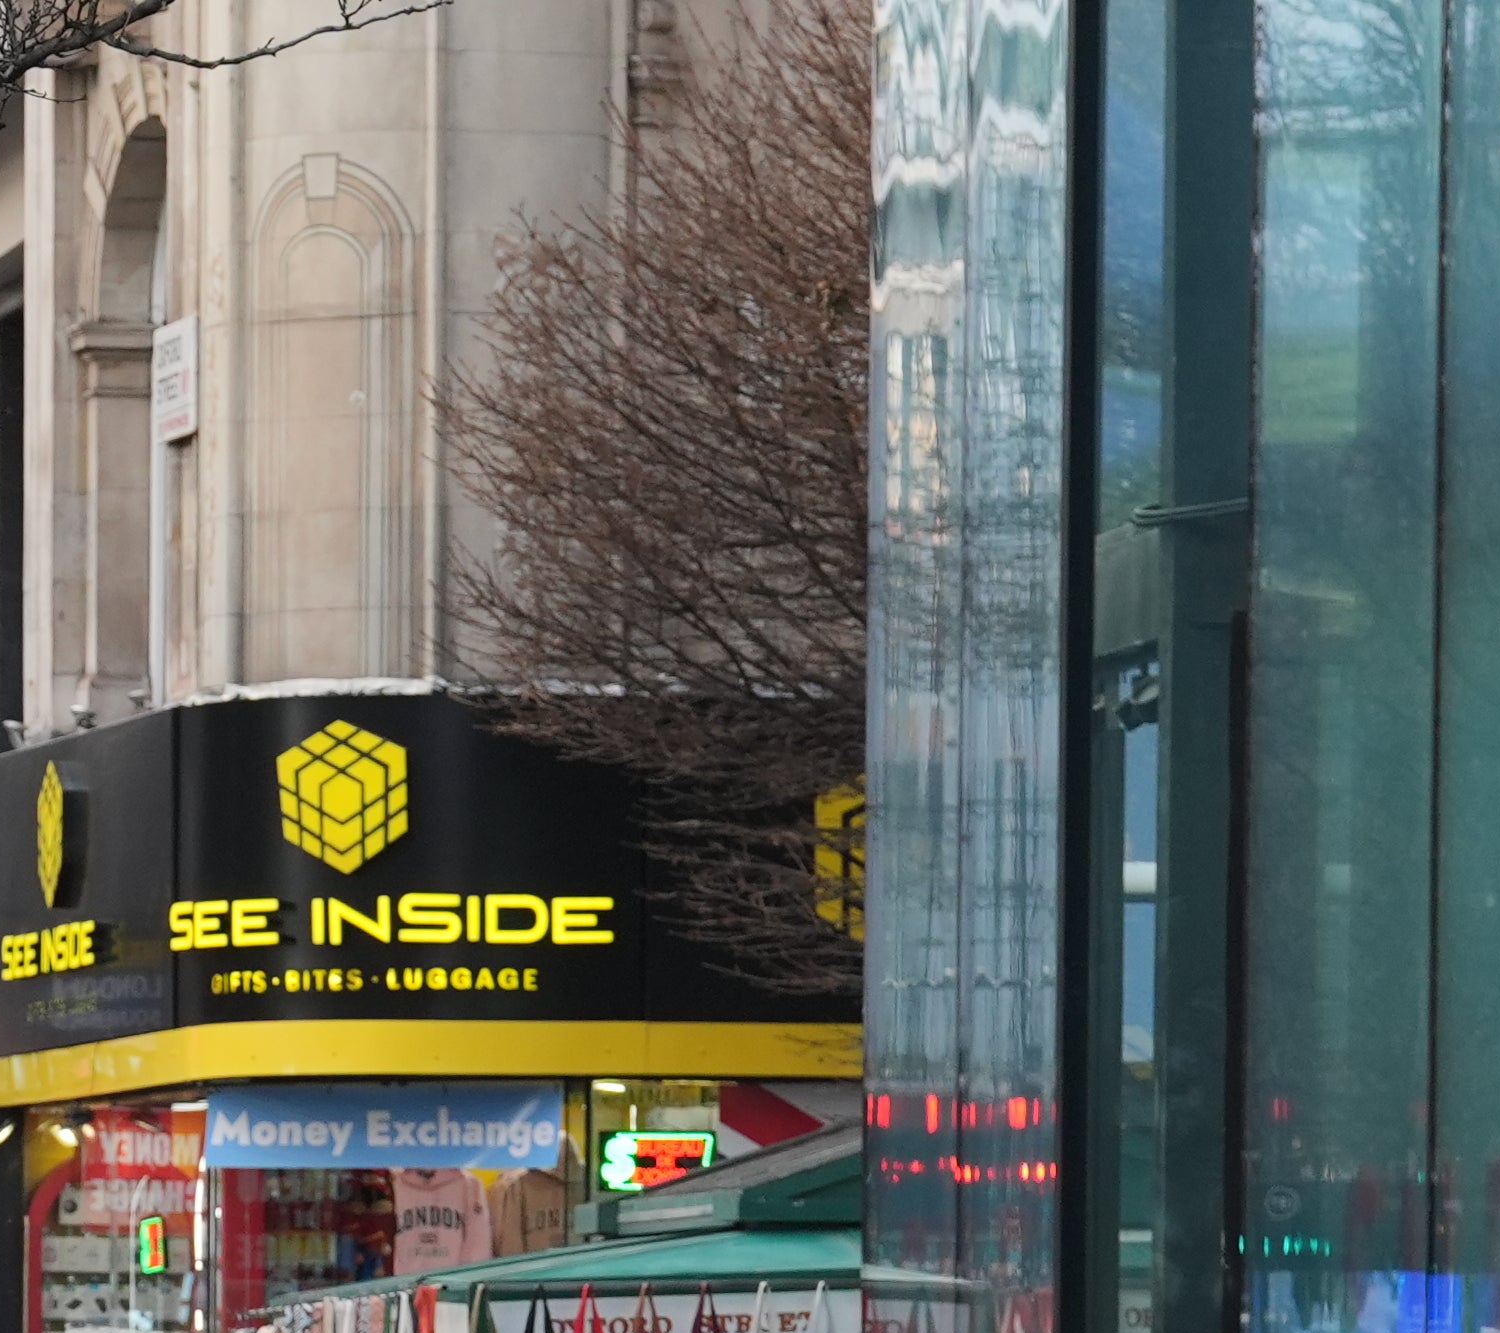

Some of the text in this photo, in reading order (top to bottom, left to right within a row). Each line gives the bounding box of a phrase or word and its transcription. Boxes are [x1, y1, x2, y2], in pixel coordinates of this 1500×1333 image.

[169, 893, 614, 951] SEE INSIDE
[1, 934, 39, 981] SEE
[40, 919, 96, 974] INSIDE
[211, 967, 538, 995] GIFTS BITES LUGGAGE
[212, 1108, 555, 1156] Money Exchange
